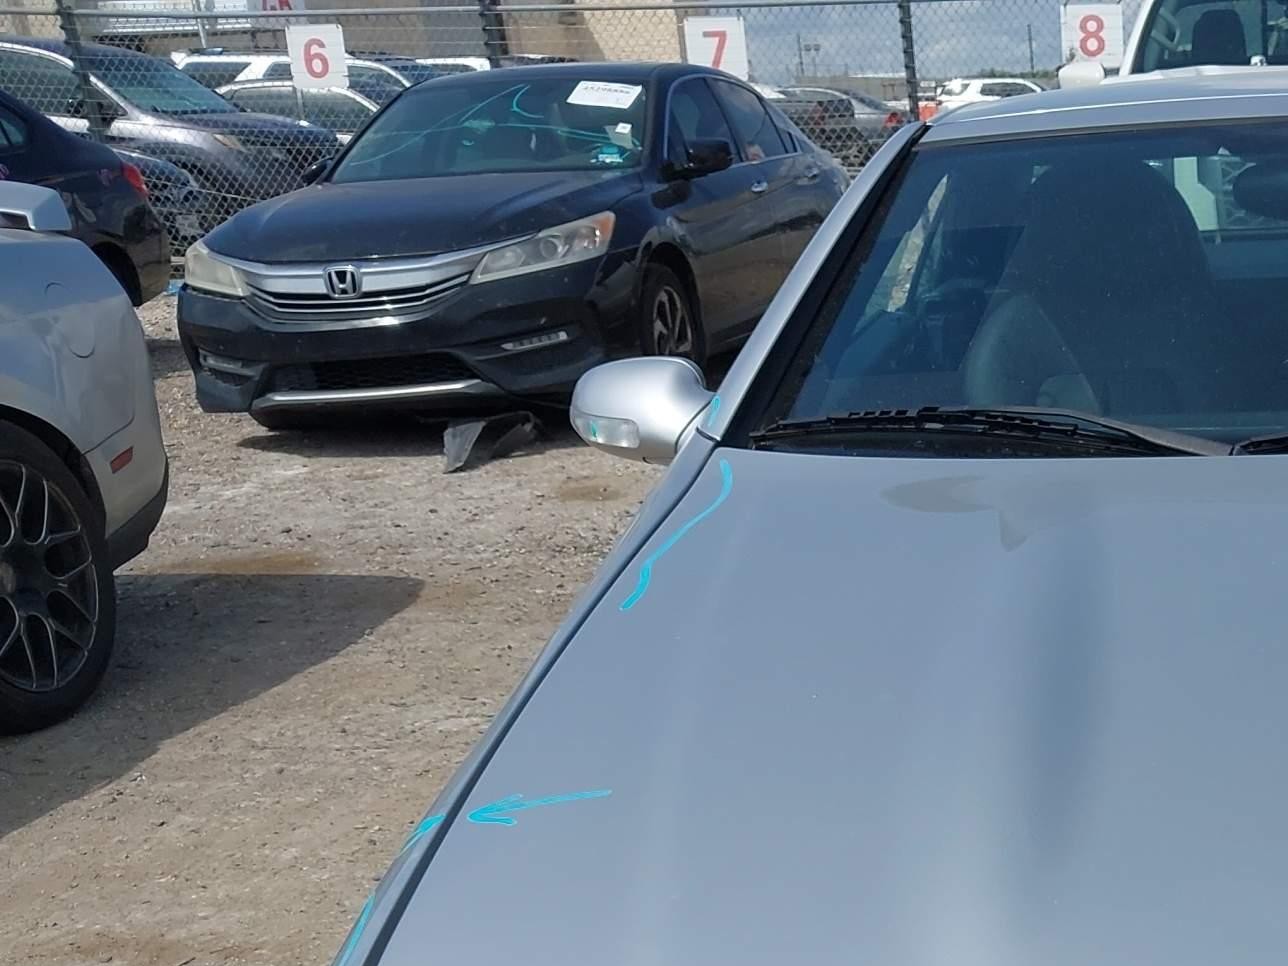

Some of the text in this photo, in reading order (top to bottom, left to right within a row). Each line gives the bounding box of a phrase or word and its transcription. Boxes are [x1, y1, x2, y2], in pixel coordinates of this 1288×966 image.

[702, 30, 727, 69] 7
[1079, 14, 1105, 57] 8
[303, 38, 329, 79] 6
